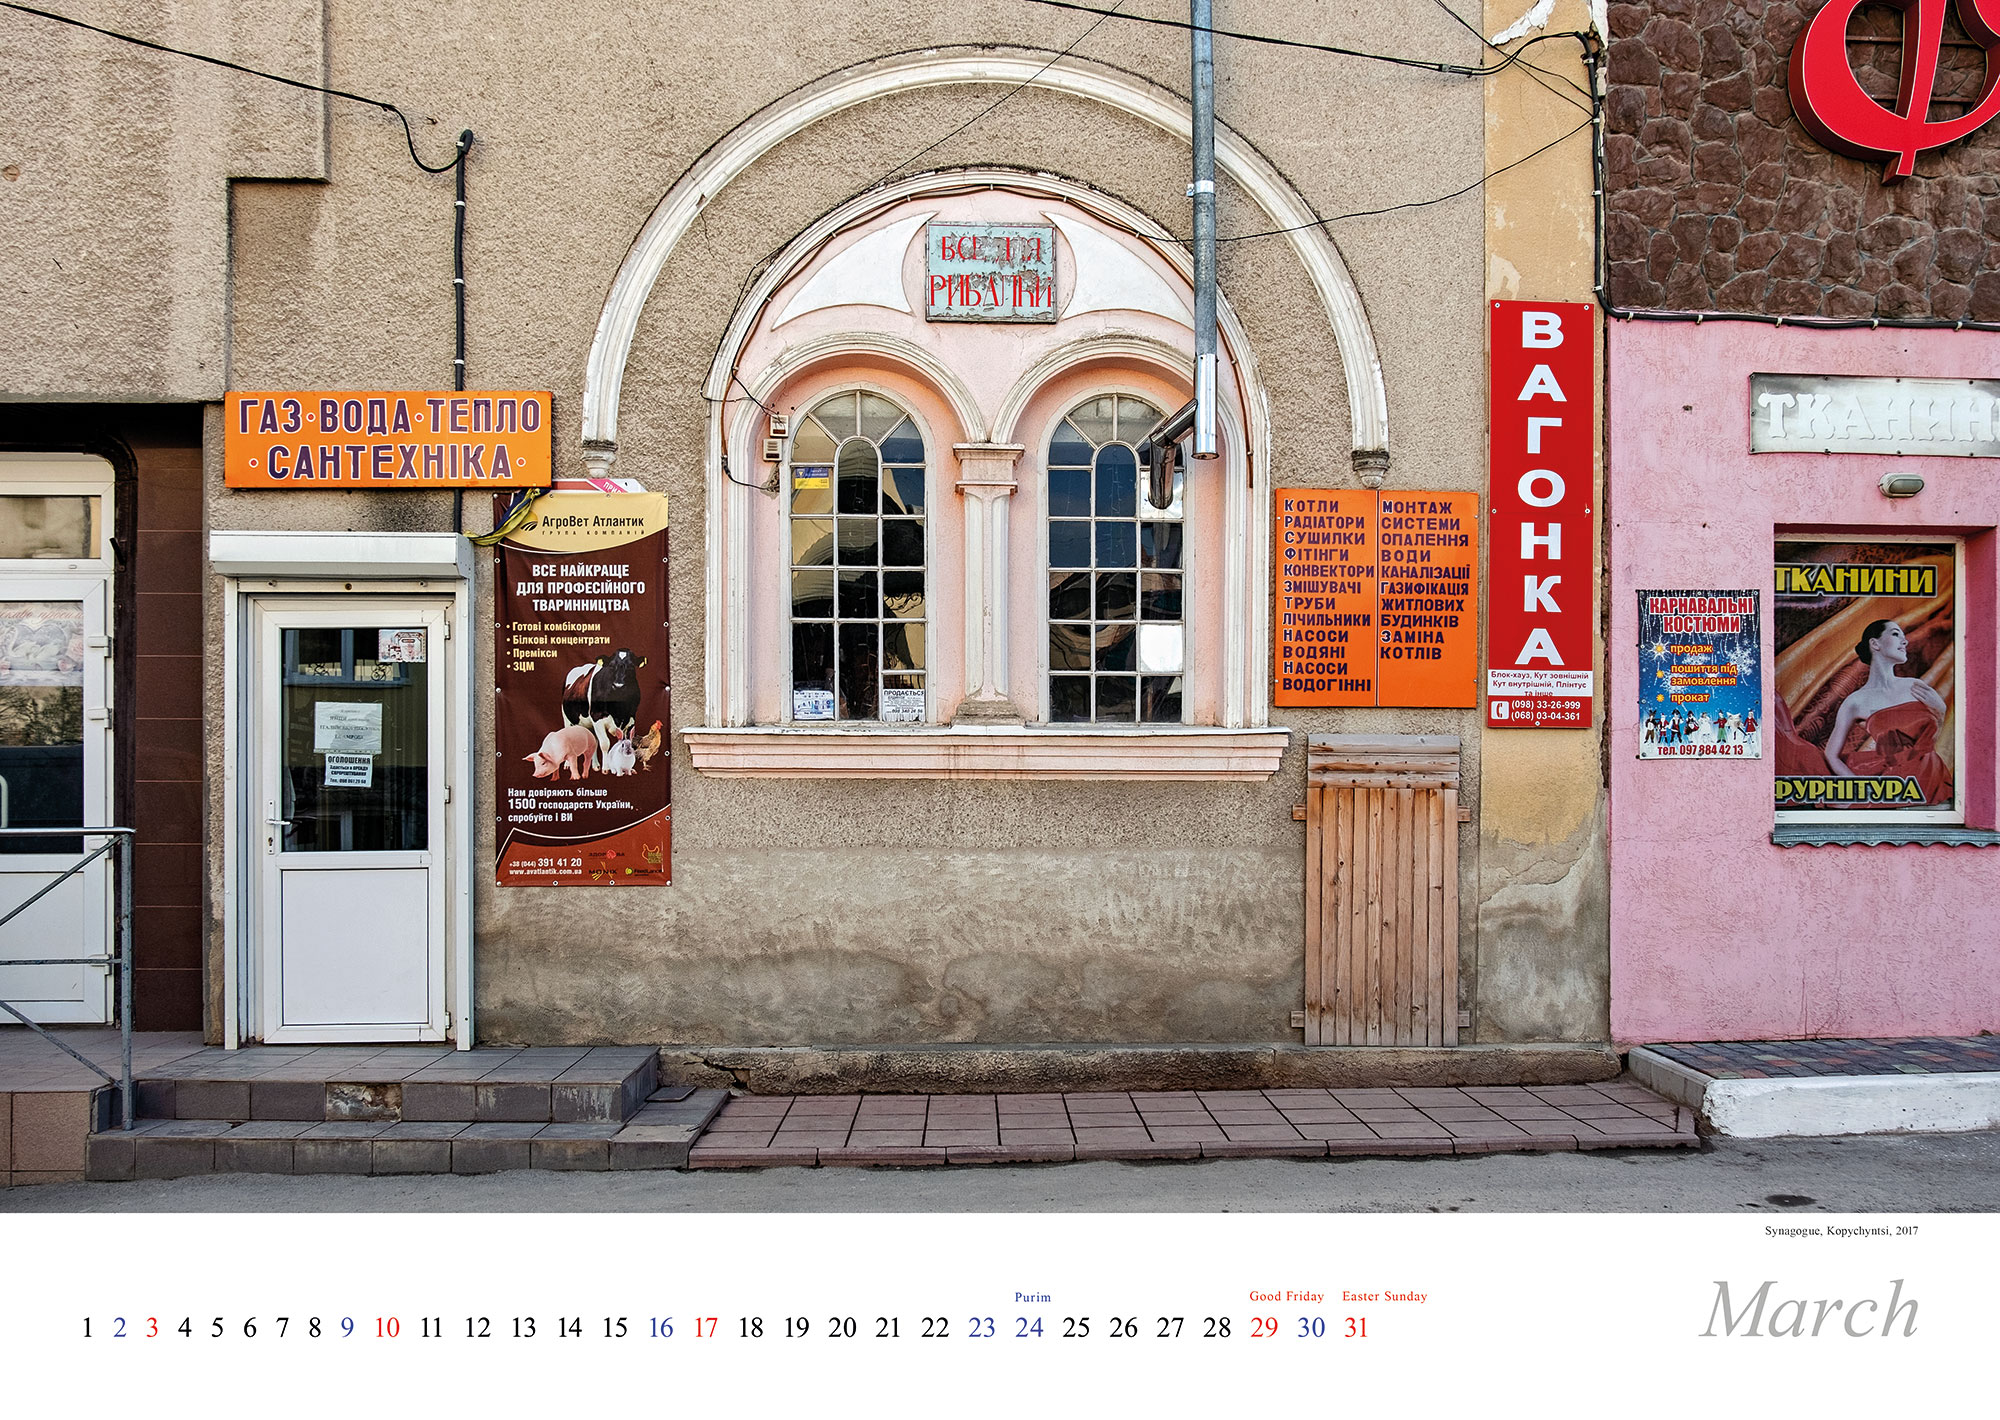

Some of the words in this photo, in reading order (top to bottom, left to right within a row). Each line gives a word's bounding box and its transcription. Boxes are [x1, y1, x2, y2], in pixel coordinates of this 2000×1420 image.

[941, 236, 987, 261] ВСЕ
[930, 274, 1052, 307] РИБАЛКИ
[239, 398, 302, 434] ГАЗ
[319, 398, 412, 437] ВОДА
[426, 398, 541, 434] ТЕПЛО
[1758, 392, 2000, 442] ТКАНИН
[267, 444, 513, 480] САНТЕХНІКА
[1514, 311, 1567, 666] ВАГОНКА
[1285, 500, 1338, 513] КОТЛИ
[1382, 501, 1452, 514] МОНТАЖ
[543, 516, 589, 529] АгроВет
[593, 516, 644, 526] Атлантик
[1285, 516, 1365, 530] РАДІАТОРИ
[1382, 518, 1460, 530] СИСТЕМИ
[1285, 532, 1365, 545] СУШИЛКИ
[1382, 534, 1468, 546] ОПАЛЕННЯ
[1285, 548, 1349, 561] ФІТІНГИ
[1382, 550, 1431, 564] ВОДИ
[532, 565, 556, 576] ВСЕ
[561, 563, 629, 578] НАЙКРАЩЕ
[1284, 564, 1374, 577] КОНВЕКТОРИ
[1382, 564, 1470, 579] КАНАЛІЗАЦІЇ
[1774, 567, 1933, 593] ТКАНИНИ
[516, 582, 543, 596] ДЛЯ
[548, 580, 645, 594] ПРОФЕСІЙНОГО
[1284, 581, 1361, 593] ЗМІШУВАЧІ
[1381, 582, 1468, 596] ГАЗИФІКАЦІЯ
[533, 599, 630, 613] ТВАРИННИЦТВА
[1285, 597, 1335, 609] ТРУБИ
[1382, 599, 1464, 611] ЖИТЛОВИХ
[1649, 598, 1753, 614] КАРНАВАЛЬНІ
[1283, 613, 1371, 626] ЛІЧИЛЬНИКИ
[1381, 615, 1459, 628] БУДИНКІВ
[1663, 616, 1740, 633] КОСТЮМИ
[512, 622, 541, 631] Готові
[544, 622, 601, 633] комбікорми
[513, 635, 547, 644] Білкові
[551, 636, 610, 646] концентрати
[1283, 630, 1348, 642] НАСОСИ
[1381, 631, 1444, 643] ЗАМІНА
[513, 648, 557, 659] Премікси
[1283, 646, 1345, 659] ВОДЯНІ
[1381, 647, 1442, 660] КОТЛІВ
[1671, 645, 1713, 654] продаж
[513, 662, 534, 672] ЗЦМ
[1284, 661, 1348, 675] НАСОСИ
[1671, 665, 1718, 674] пошиття
[1720, 663, 1737, 675] під
[1534, 672, 1547, 680] Кут
[1671, 678, 1737, 686] замовлення
[1283, 679, 1371, 692] ВОДОГІННІ
[1493, 680, 1506, 688] Кут
[1556, 681, 1586, 689] Плінтус
[1511, 700, 1534, 709] (098)
[1537, 701, 1580, 709] 33-26-999
[1671, 693, 1710, 703] прокат
[1511, 711, 1534, 720] (068)
[1537, 712, 1580, 720] 03-04-361
[1658, 746, 1677, 755] тел.
[1680, 744, 1697, 755] 097
[1719, 744, 1730, 755] 42
[1733, 744, 1743, 755] 13
[328, 756, 370, 764] ОГОЛОШЕННЯ
[508, 788, 525, 796] Нам
[528, 788, 573, 798] довіряють
[577, 788, 607, 796] більше
[509, 799, 535, 809] 1500
[539, 801, 593, 810] господарств
[596, 800, 633, 810] України,
[508, 813, 552, 823] спробуйте
[561, 813, 573, 821] ВИ
[538, 858, 553, 866] 391
[557, 858, 567, 866] 41
[571, 858, 581, 866] 20
